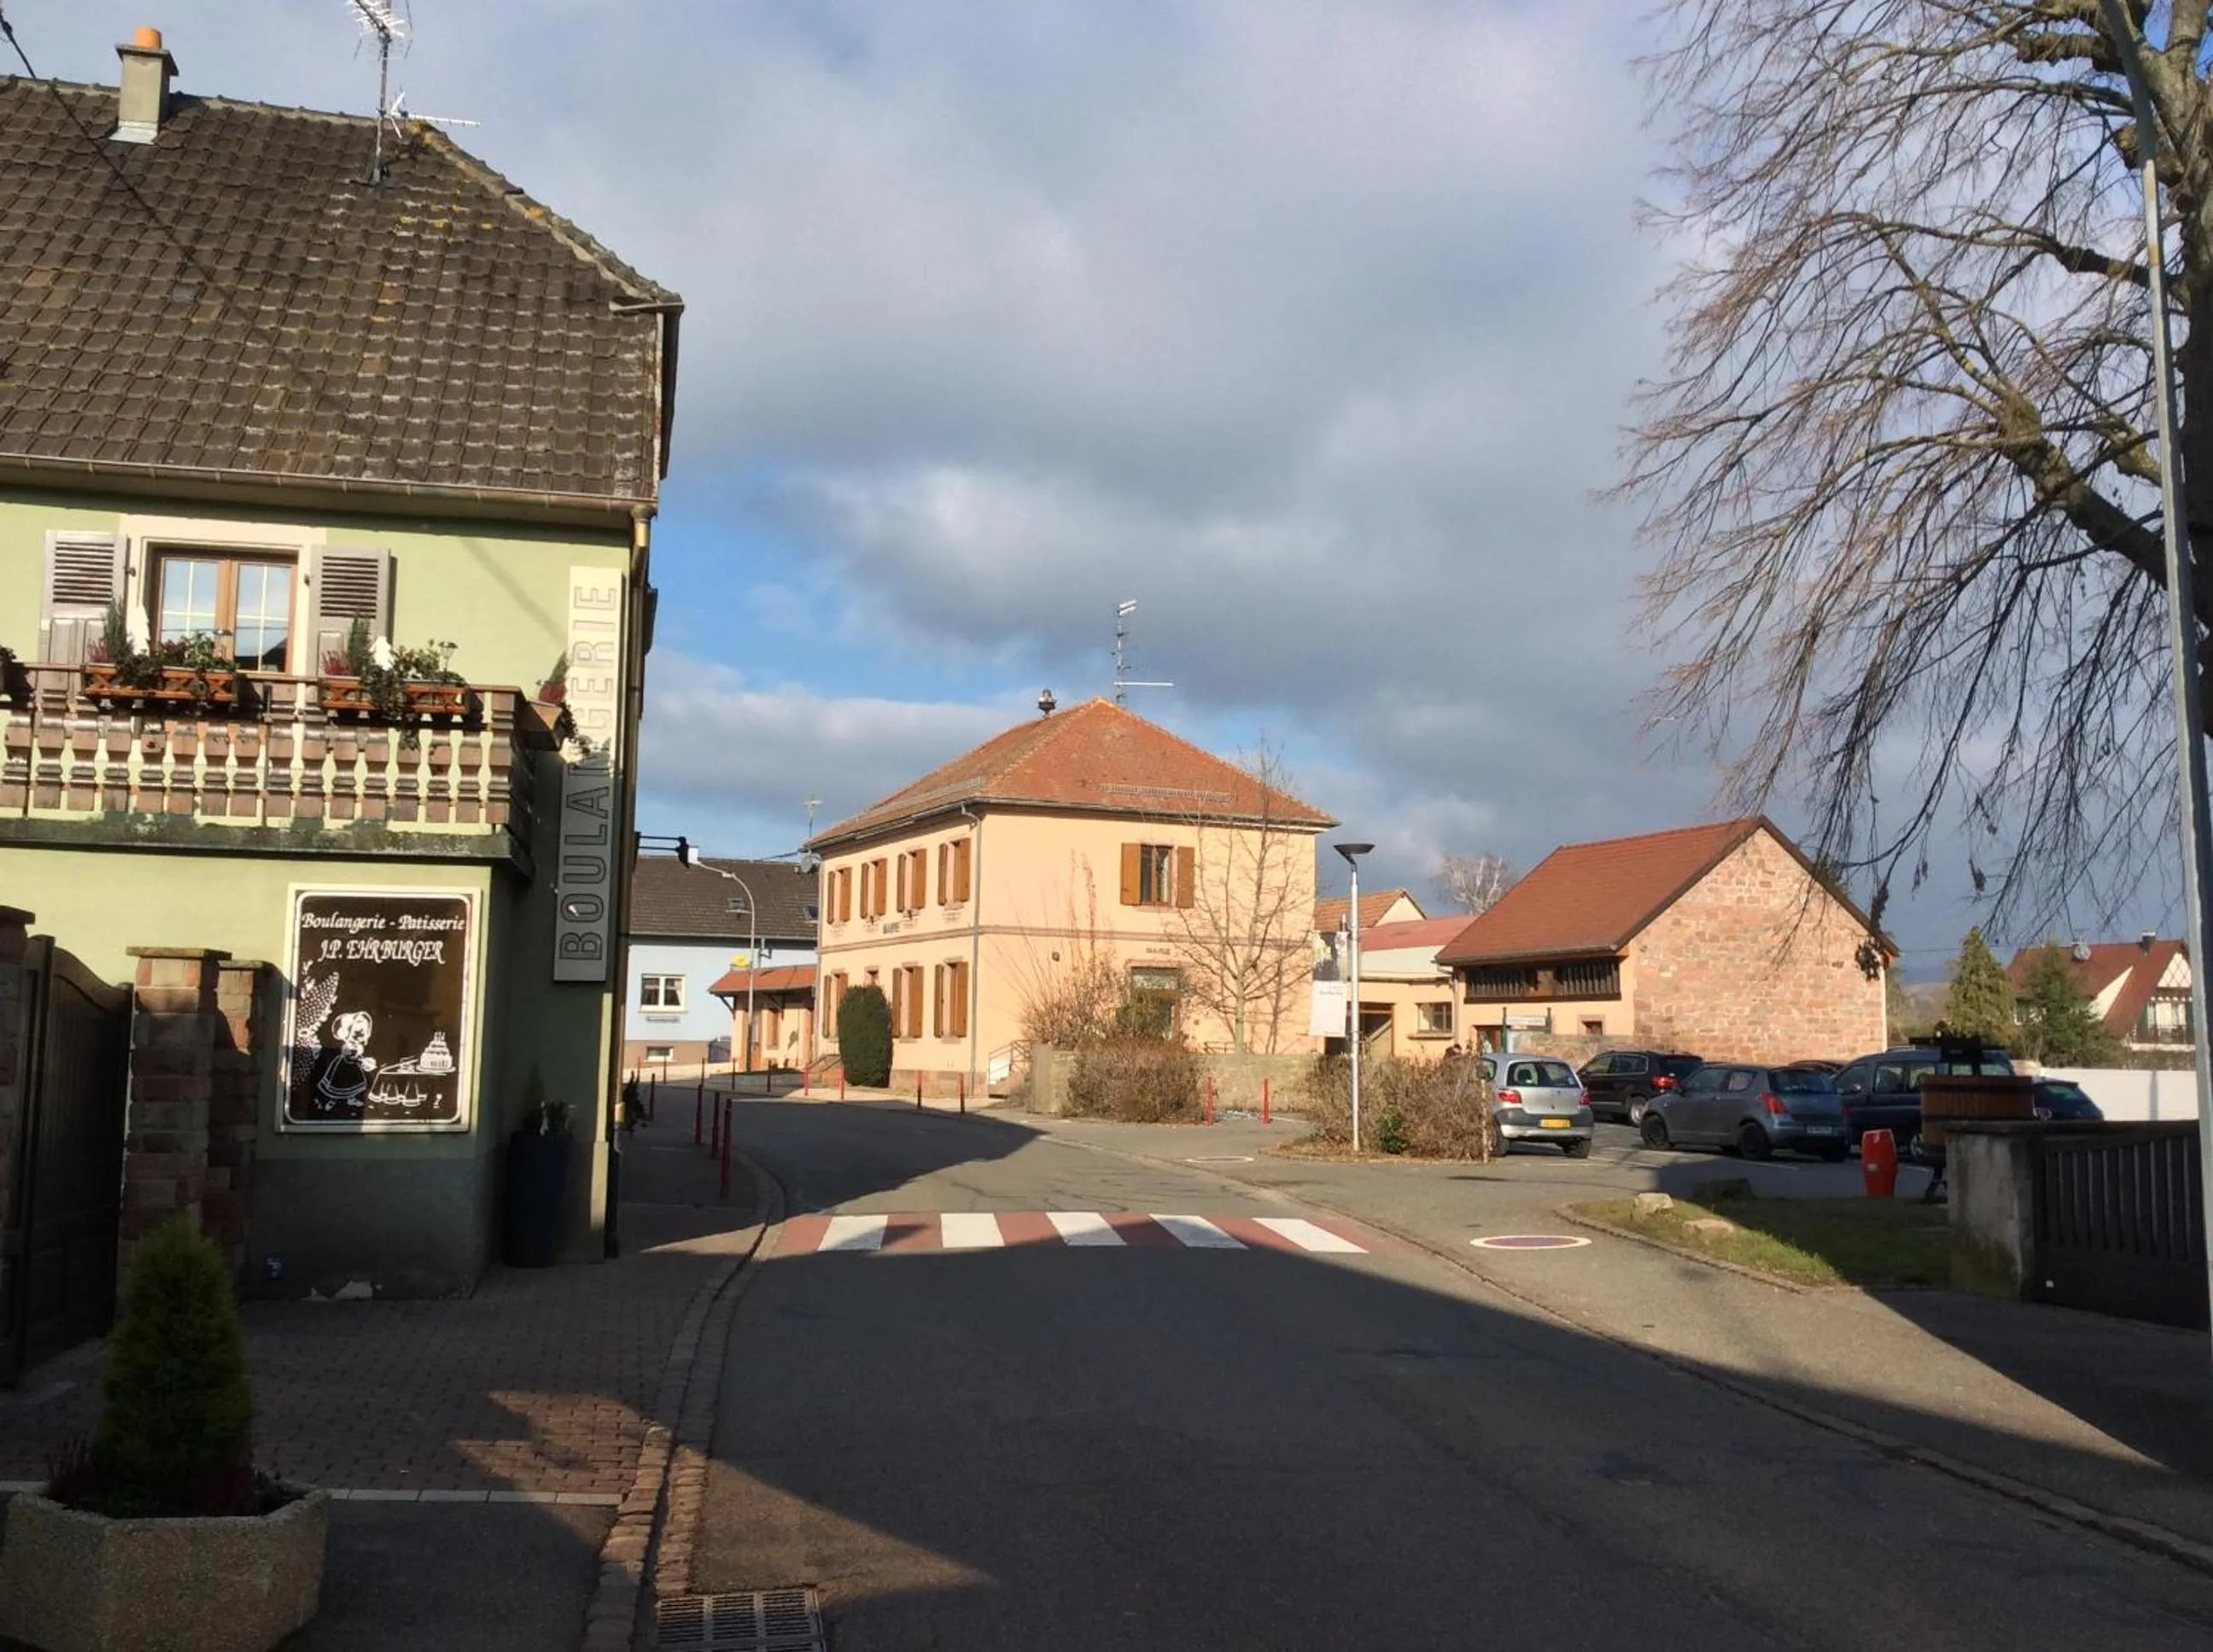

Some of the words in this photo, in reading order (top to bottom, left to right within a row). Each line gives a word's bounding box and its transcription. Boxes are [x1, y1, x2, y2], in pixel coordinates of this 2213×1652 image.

[301, 911, 386, 934] Boulangerie
[398, 914, 465, 931] Patisserie
[347, 937, 446, 966] EHRBURGER
